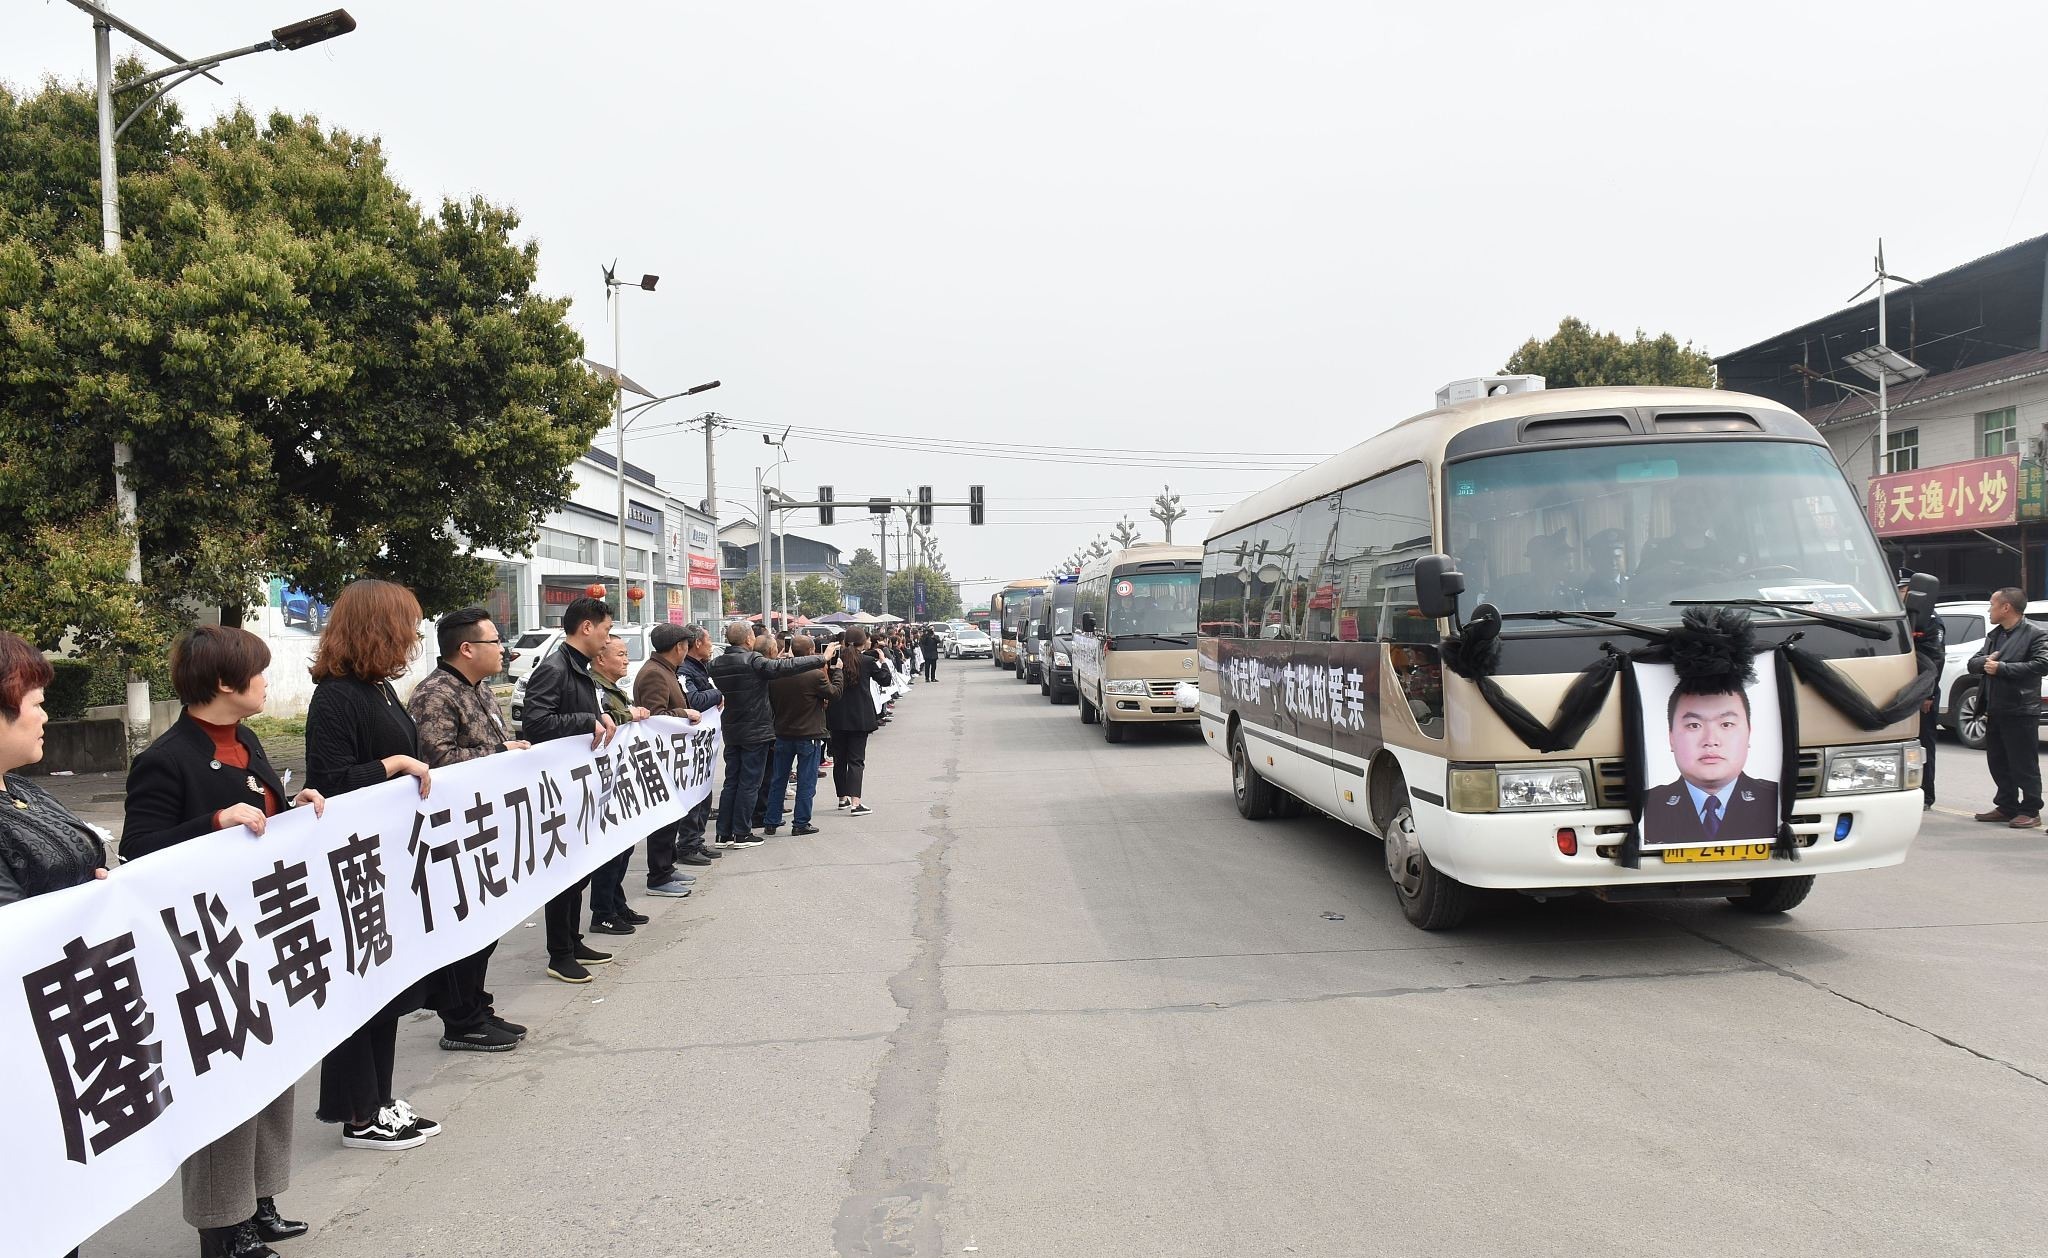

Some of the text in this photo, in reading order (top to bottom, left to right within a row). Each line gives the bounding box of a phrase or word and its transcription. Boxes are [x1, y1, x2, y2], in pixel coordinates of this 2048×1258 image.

[1890, 469, 2008, 524] 天逸小炒
[22, 832, 393, 1165] 鏖战毒魔
[407, 769, 567, 934] 行走刀尖
[570, 735, 670, 845] 不畏病痛
